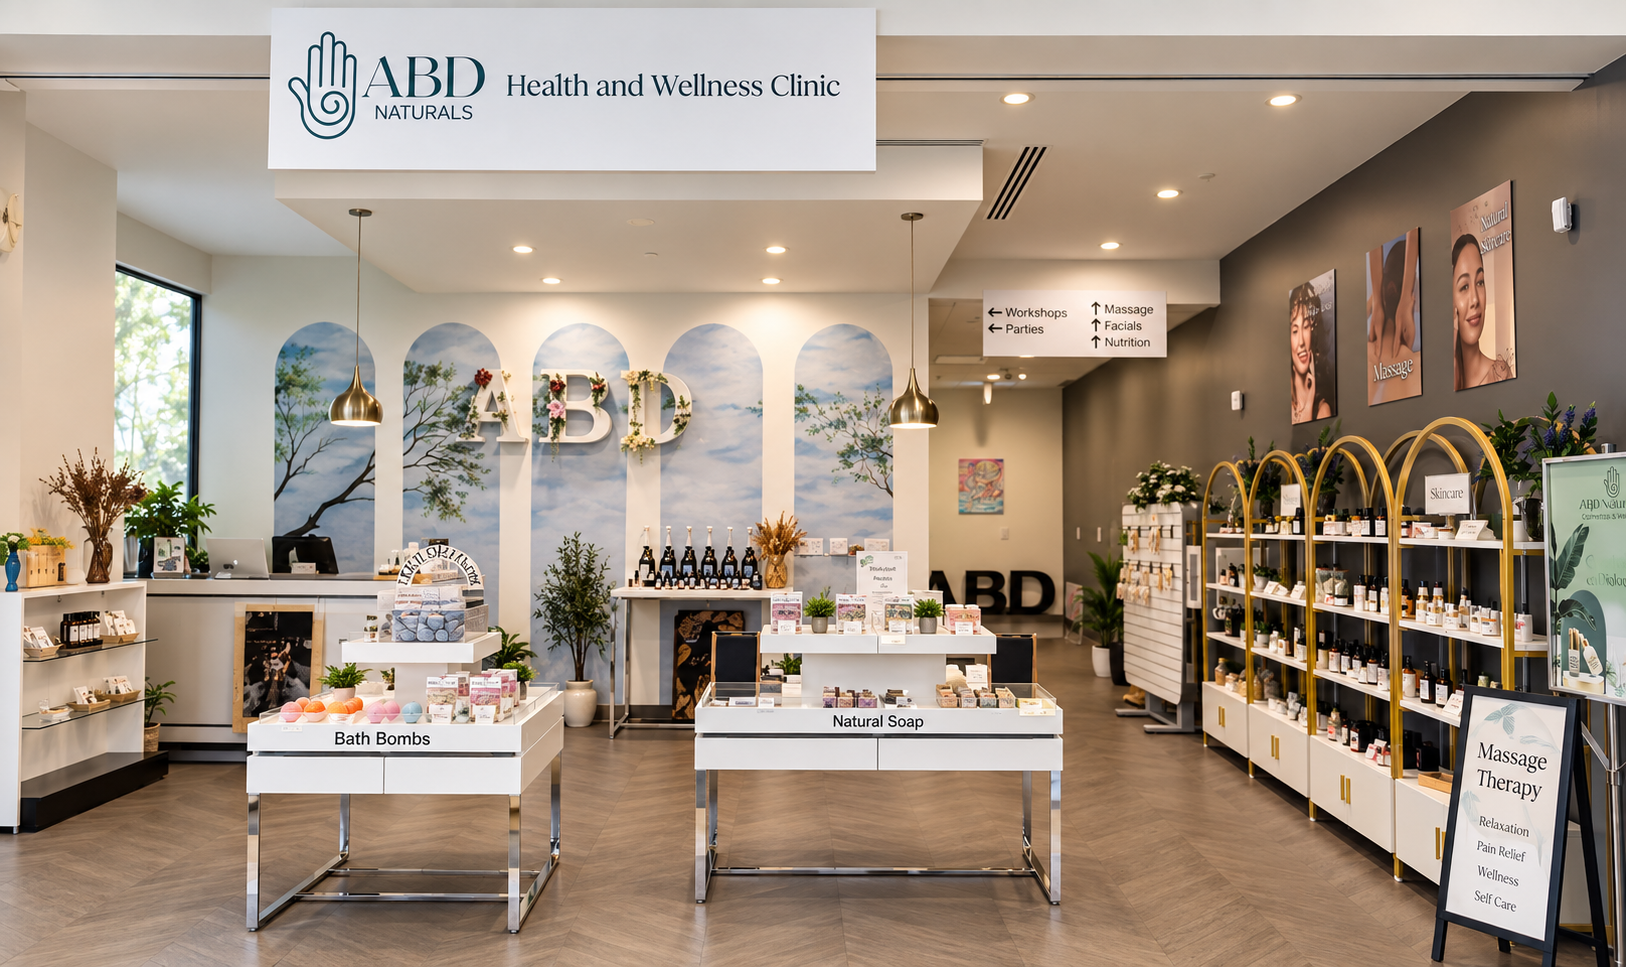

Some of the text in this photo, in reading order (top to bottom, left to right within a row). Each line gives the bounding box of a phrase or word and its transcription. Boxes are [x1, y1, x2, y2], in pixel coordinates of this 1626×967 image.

[361, 55, 486, 98] ABD
[506, 72, 841, 97] Health and Wellness Clinic
[374, 104, 474, 121] NATURALS
[1005, 307, 1068, 320] Workshops
[1104, 304, 1154, 317] Massage
[1005, 323, 1045, 335] Parties
[1104, 320, 1143, 331] Facials
[1104, 337, 1151, 348] Nutrition
[1373, 359, 1414, 382] Massage
[456, 368, 693, 445] ABD
[1430, 487, 1464, 500] Skincare
[1579, 498, 1600, 511] ABD
[929, 570, 1055, 615] ABD
[833, 714, 924, 731] Natural Soap
[334, 731, 431, 746] Bath Bombs
[1477, 742, 1547, 774] Massage
[1477, 769, 1542, 803] Therapy
[1479, 815, 1529, 838] Relaxation
[1477, 840, 1526, 862] Pain Relief
[1477, 865, 1519, 887] Wellness
[1474, 890, 1517, 912] Self Care
